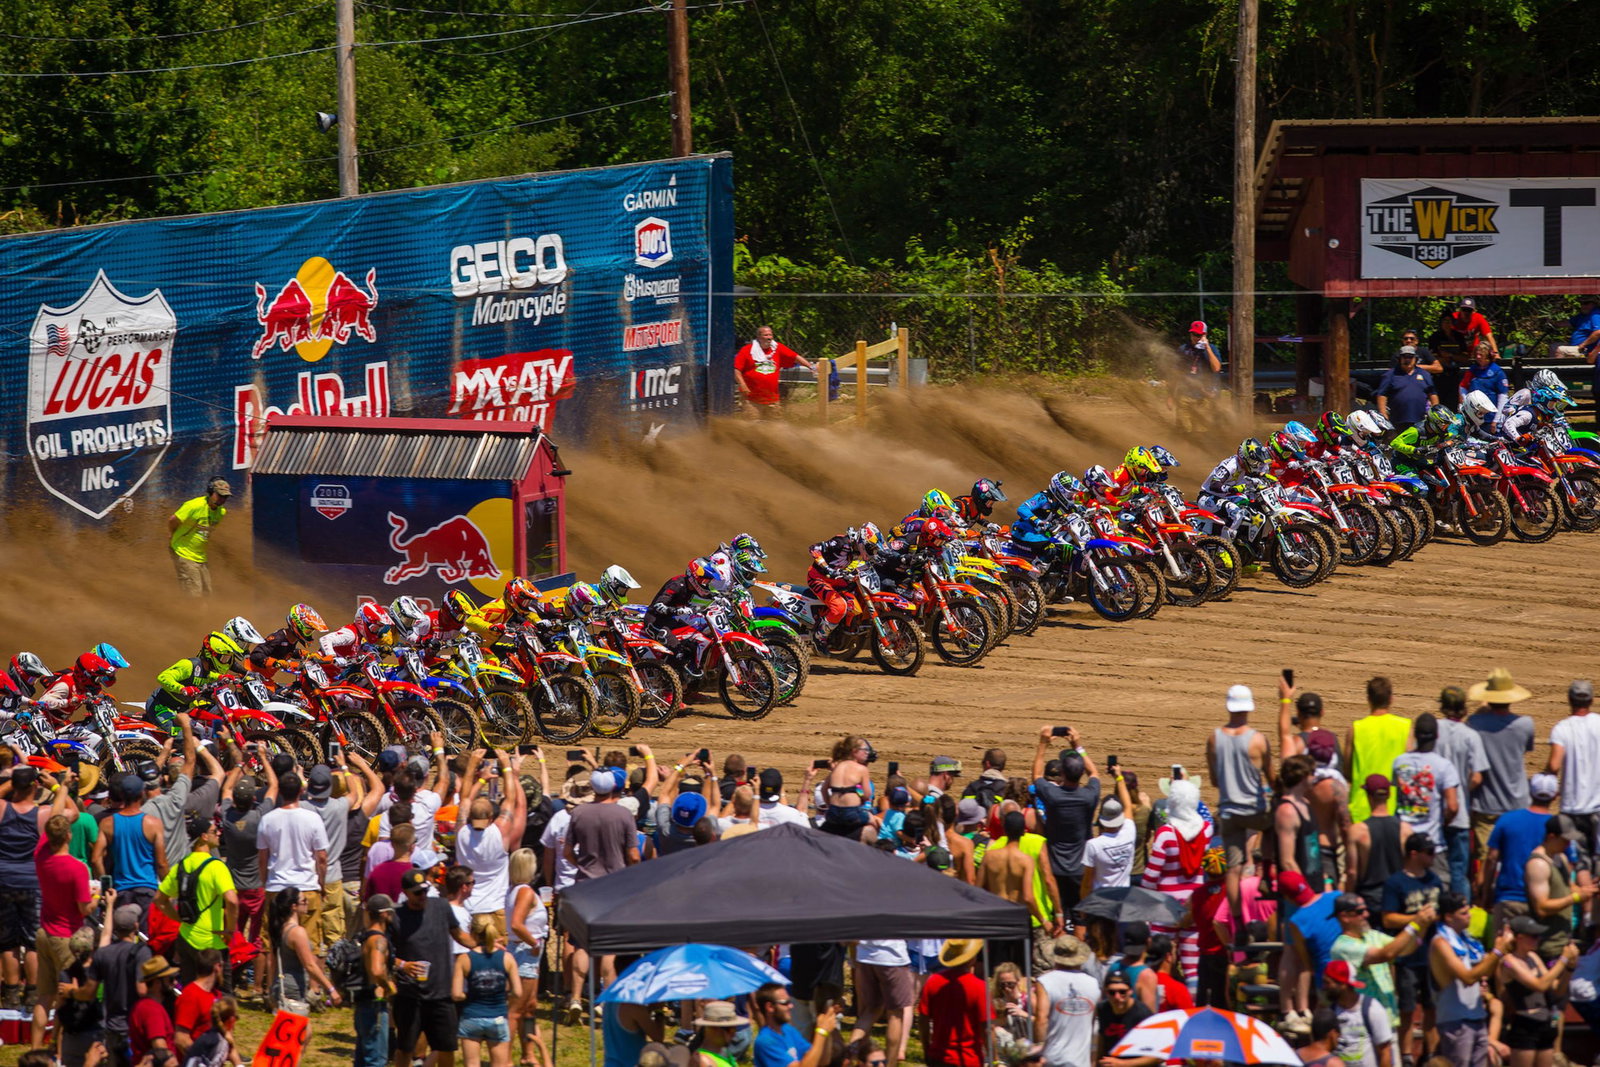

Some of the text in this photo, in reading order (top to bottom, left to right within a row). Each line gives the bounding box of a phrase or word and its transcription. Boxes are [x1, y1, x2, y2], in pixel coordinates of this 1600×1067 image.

[623, 189, 677, 212] GARMIN
[1368, 208, 1412, 232] THE
[639, 229, 667, 255] 100%
[1418, 245, 1448, 260] 338
[451, 233, 568, 298] GEICO
[472, 290, 567, 326] Motorcycle
[107, 330, 171, 347] PERFORMANCE
[43, 348, 163, 415] LUCAS
[448, 366, 508, 413] MX
[508, 356, 573, 402] ATV
[35, 419, 169, 460] OIL PRODUCTS
[81, 466, 120, 492] INC.
[319, 488, 343, 497] 2018
[784, 597, 805, 613] 25
[223, 691, 235, 707] 6
